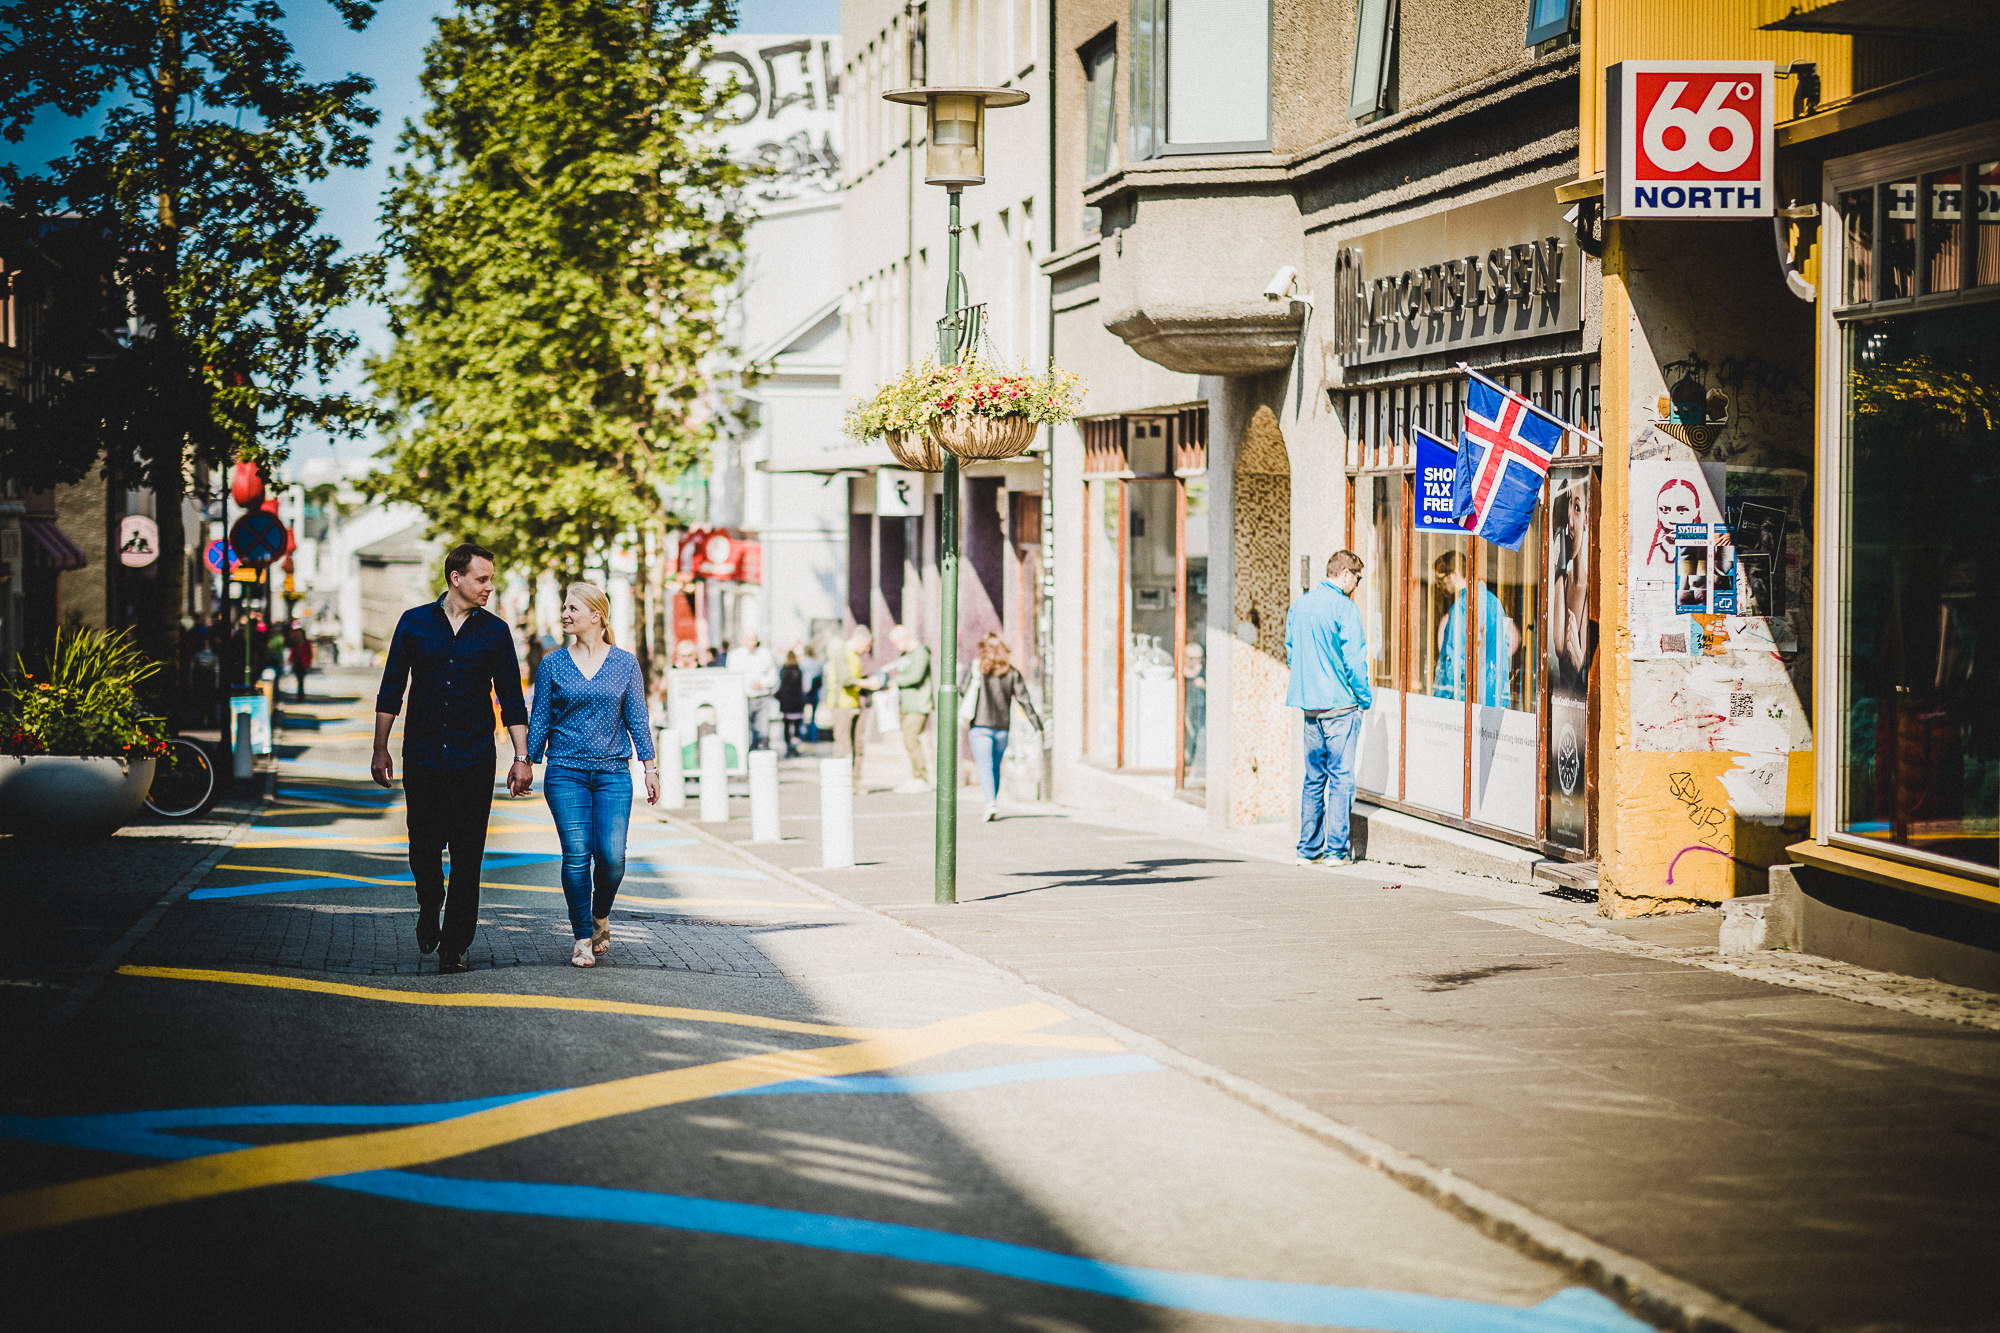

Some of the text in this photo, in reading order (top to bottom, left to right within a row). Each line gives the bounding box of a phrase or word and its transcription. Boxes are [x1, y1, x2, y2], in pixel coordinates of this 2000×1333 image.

[1634, 186, 1762, 209] NORTH
[1360, 236, 1561, 328] MICHELSEN
[1423, 482, 1452, 497] TAX
